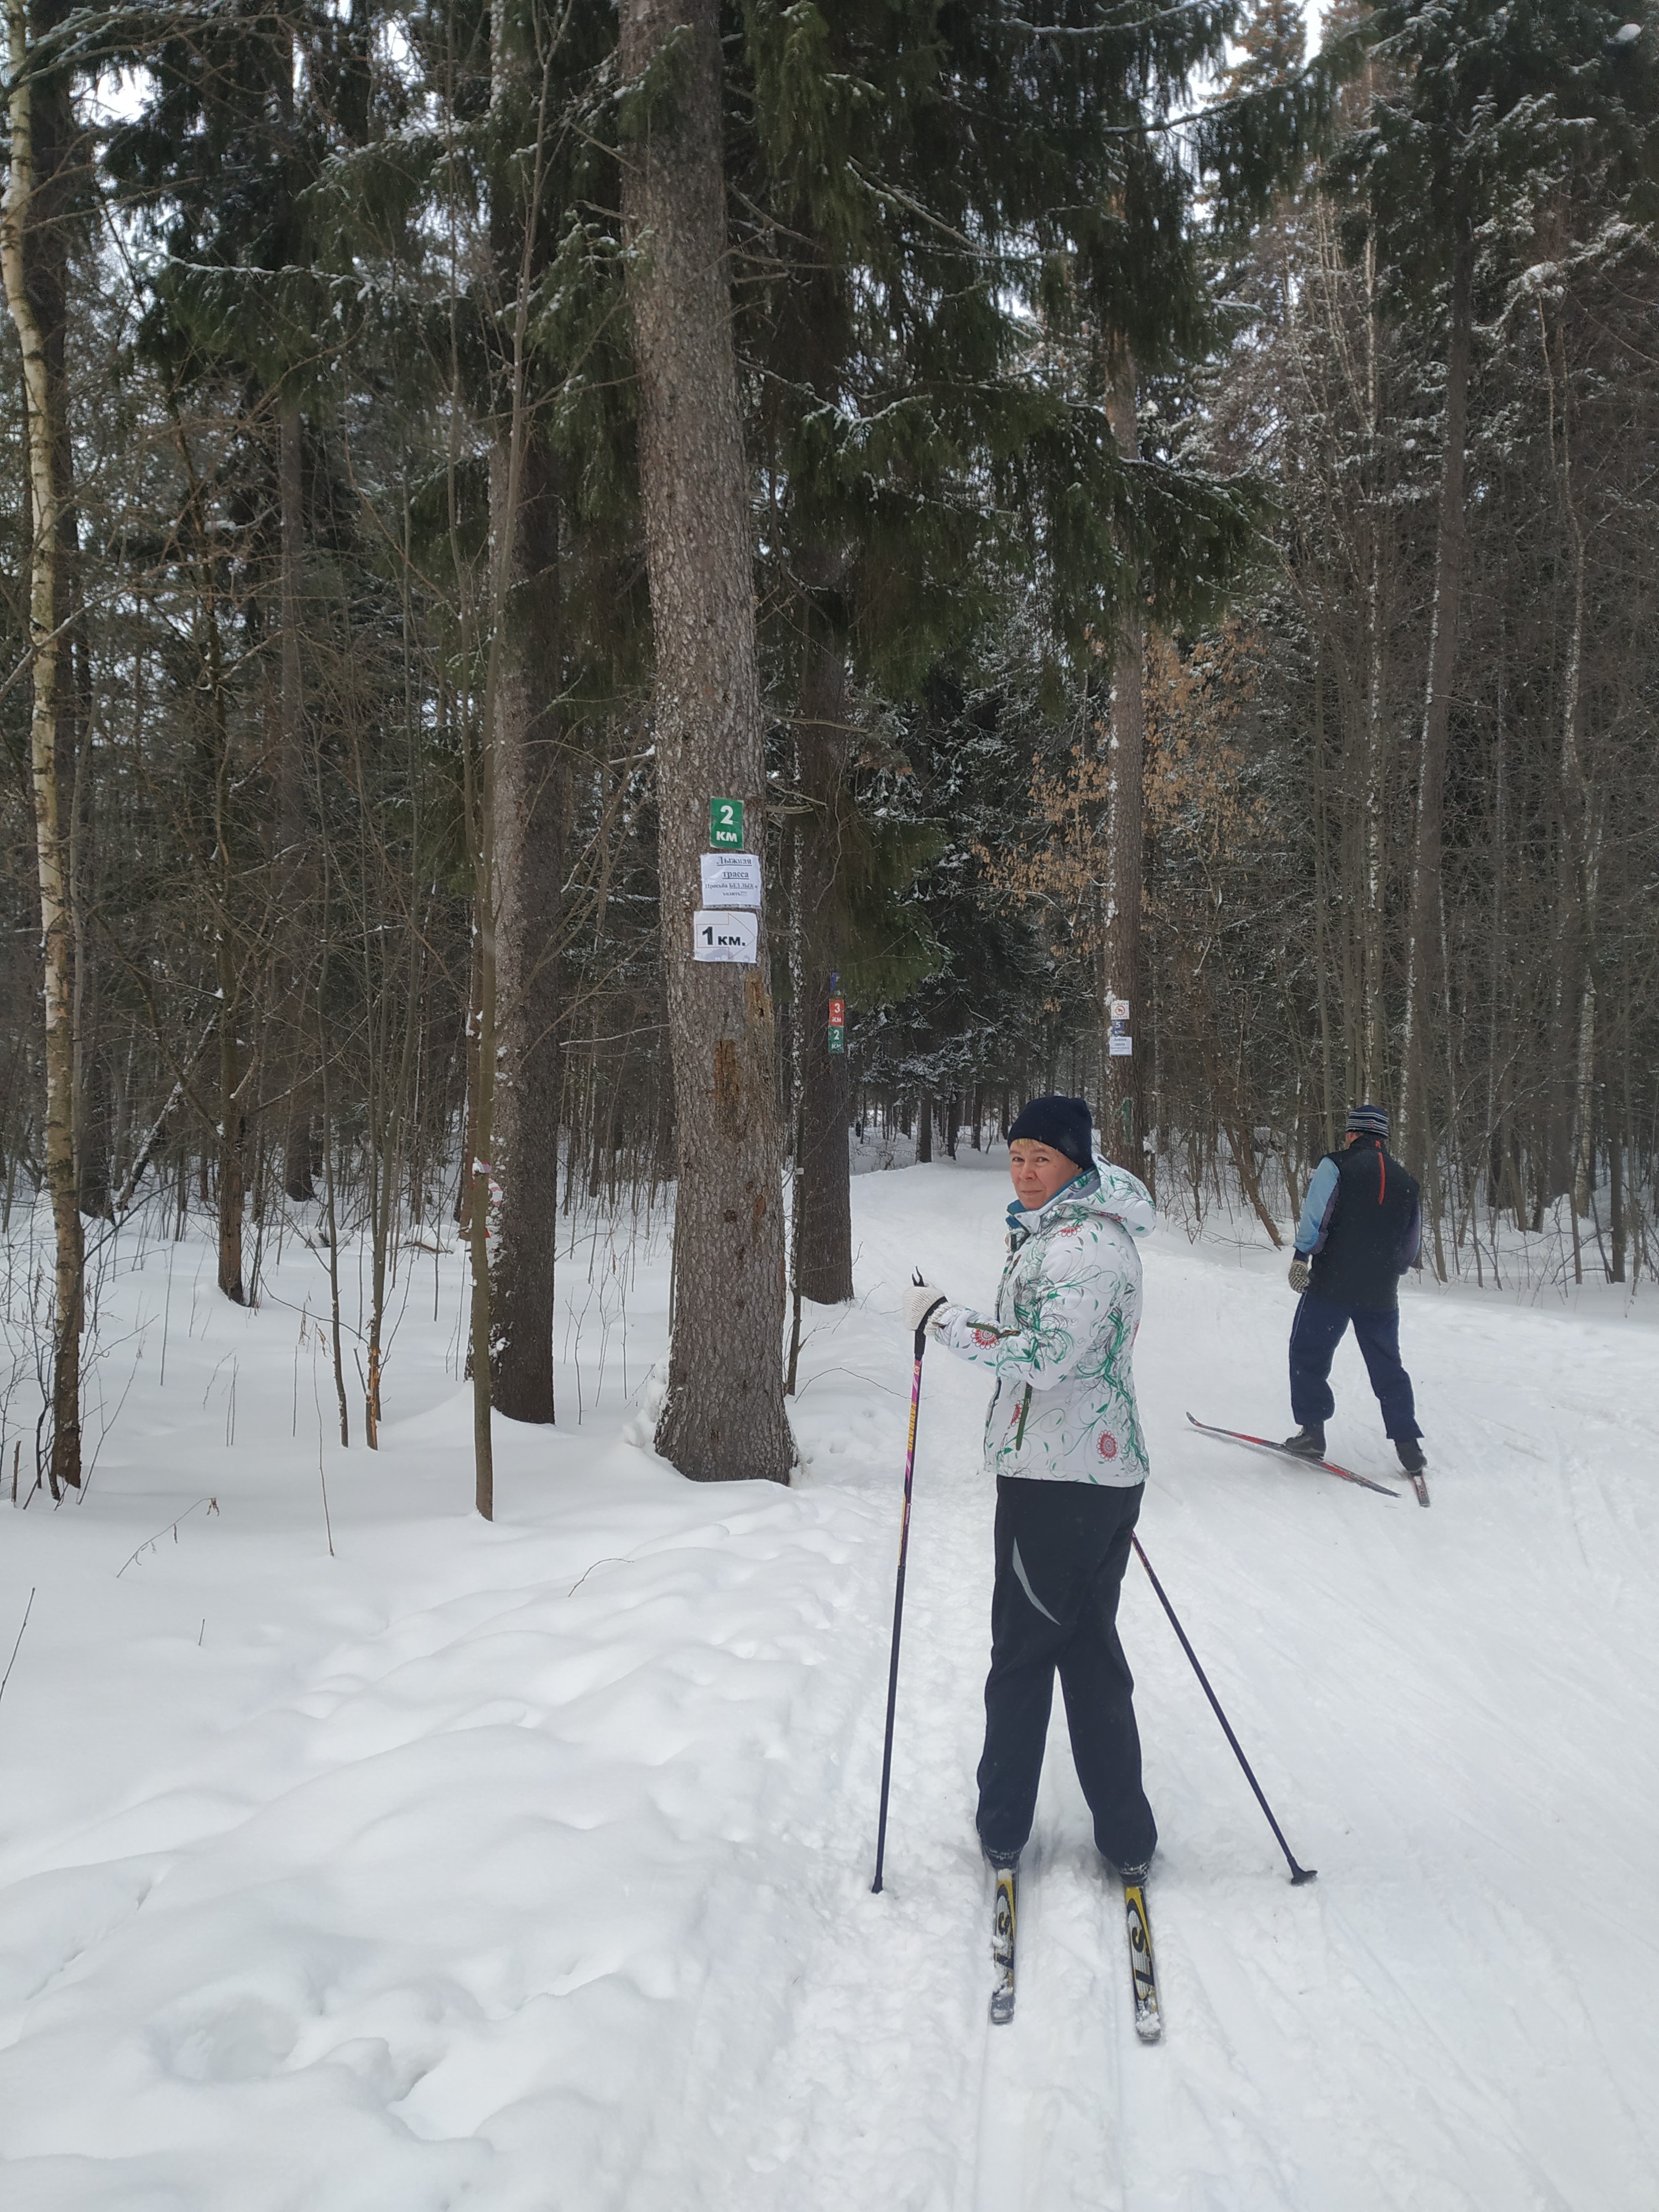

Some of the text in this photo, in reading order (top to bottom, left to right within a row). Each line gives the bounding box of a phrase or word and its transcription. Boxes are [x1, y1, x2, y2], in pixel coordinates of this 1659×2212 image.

[720, 805, 734, 825] 2
[702, 926, 746, 946] 1 км.
[834, 1003, 841, 1013] 3
[834, 1030, 839, 1040] 2
